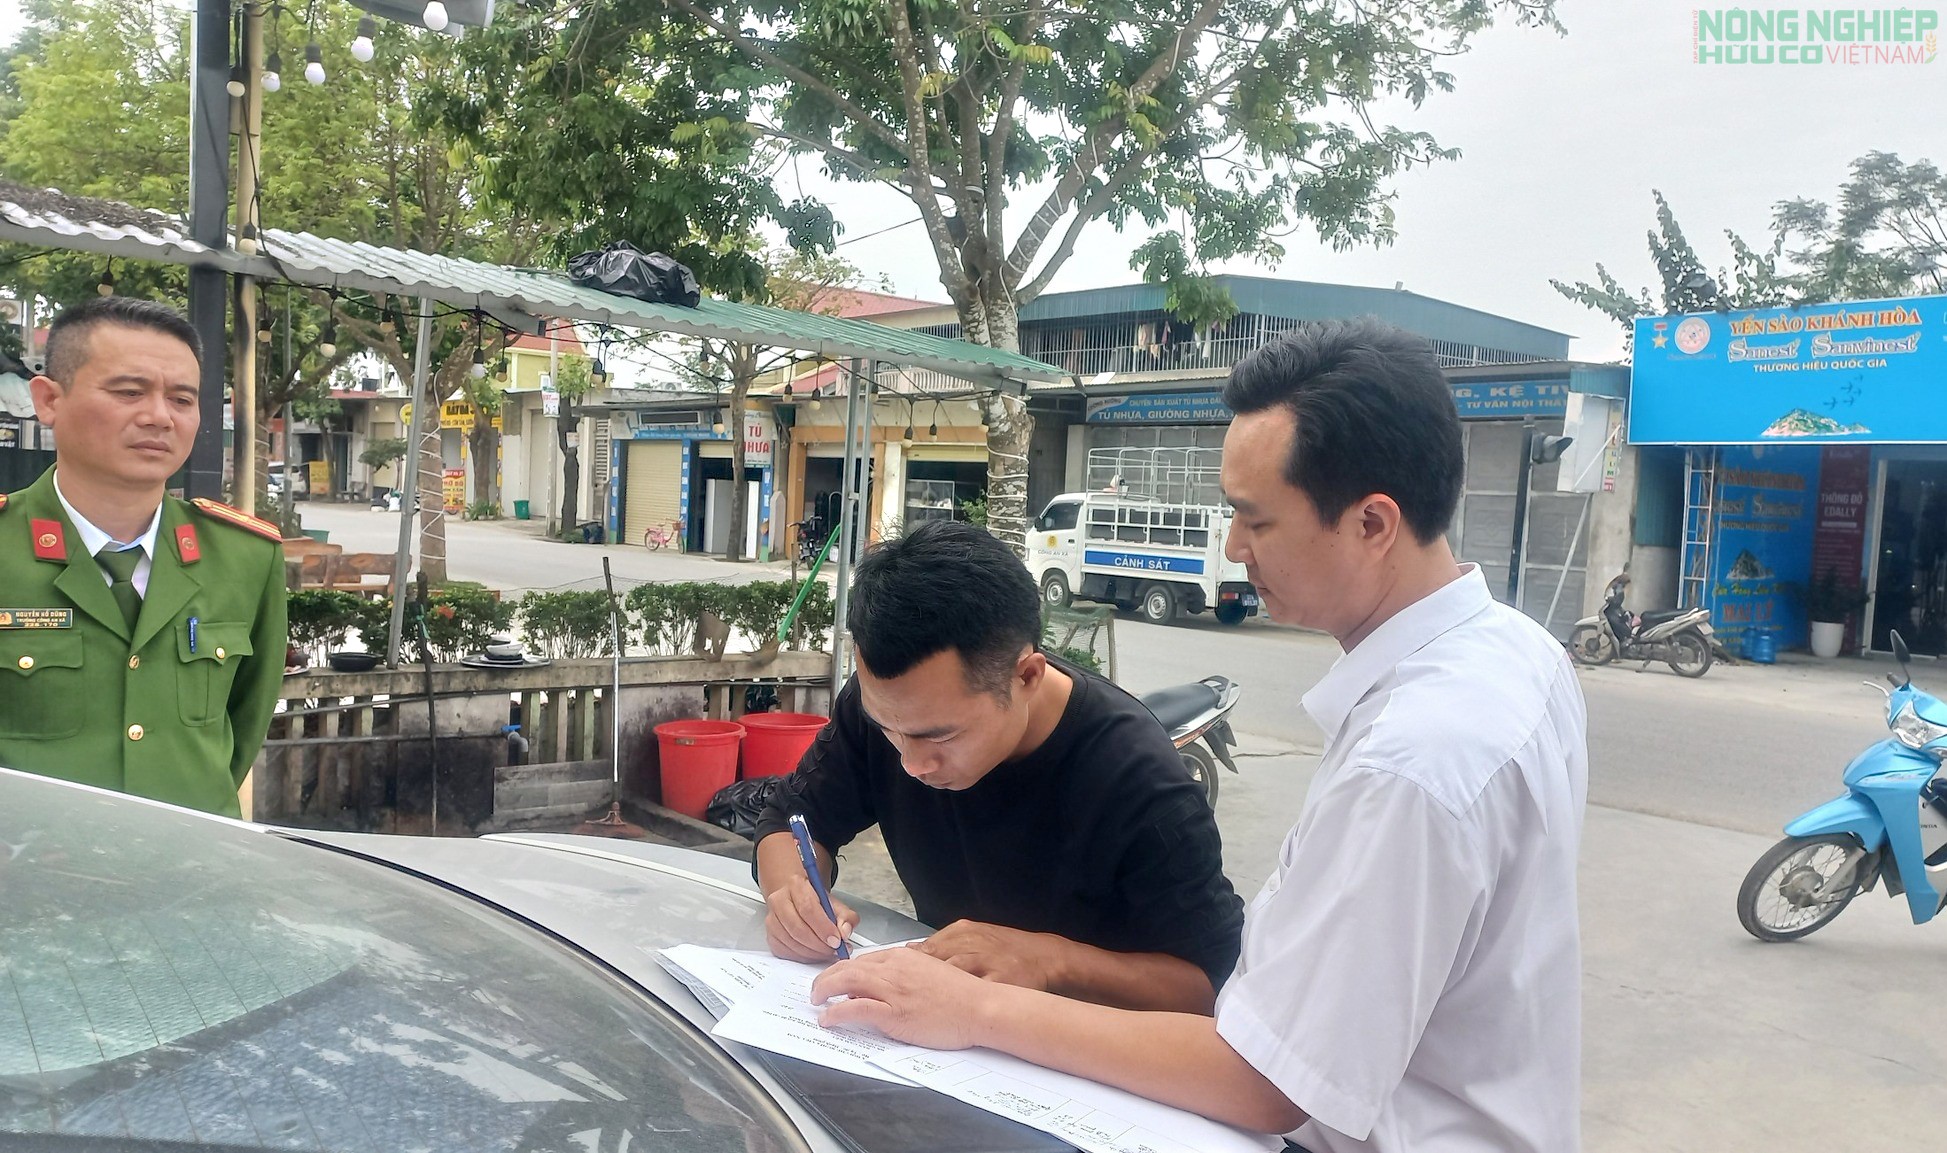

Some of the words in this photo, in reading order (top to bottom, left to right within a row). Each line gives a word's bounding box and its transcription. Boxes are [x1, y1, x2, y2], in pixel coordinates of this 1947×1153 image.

[1729, 315, 1765, 336] YẾN
[1767, 313, 1803, 335] SÀO
[1805, 310, 1875, 332] KHÁNH
[1878, 306, 1922, 328] HÒA
[1753, 361, 1800, 373] THƯƠNG
[1802, 360, 1828, 372] HIỆU
[1830, 358, 1864, 371] QUỐC
[1867, 358, 1888, 369] GIA
[1098, 409, 1110, 420] TỦ
[1148, 409, 1190, 419] GIƯỜNG
[749, 422, 762, 438] TỦ
[1114, 554, 1144, 569] CẢNH
[1148, 557, 1171, 571] SÁT
